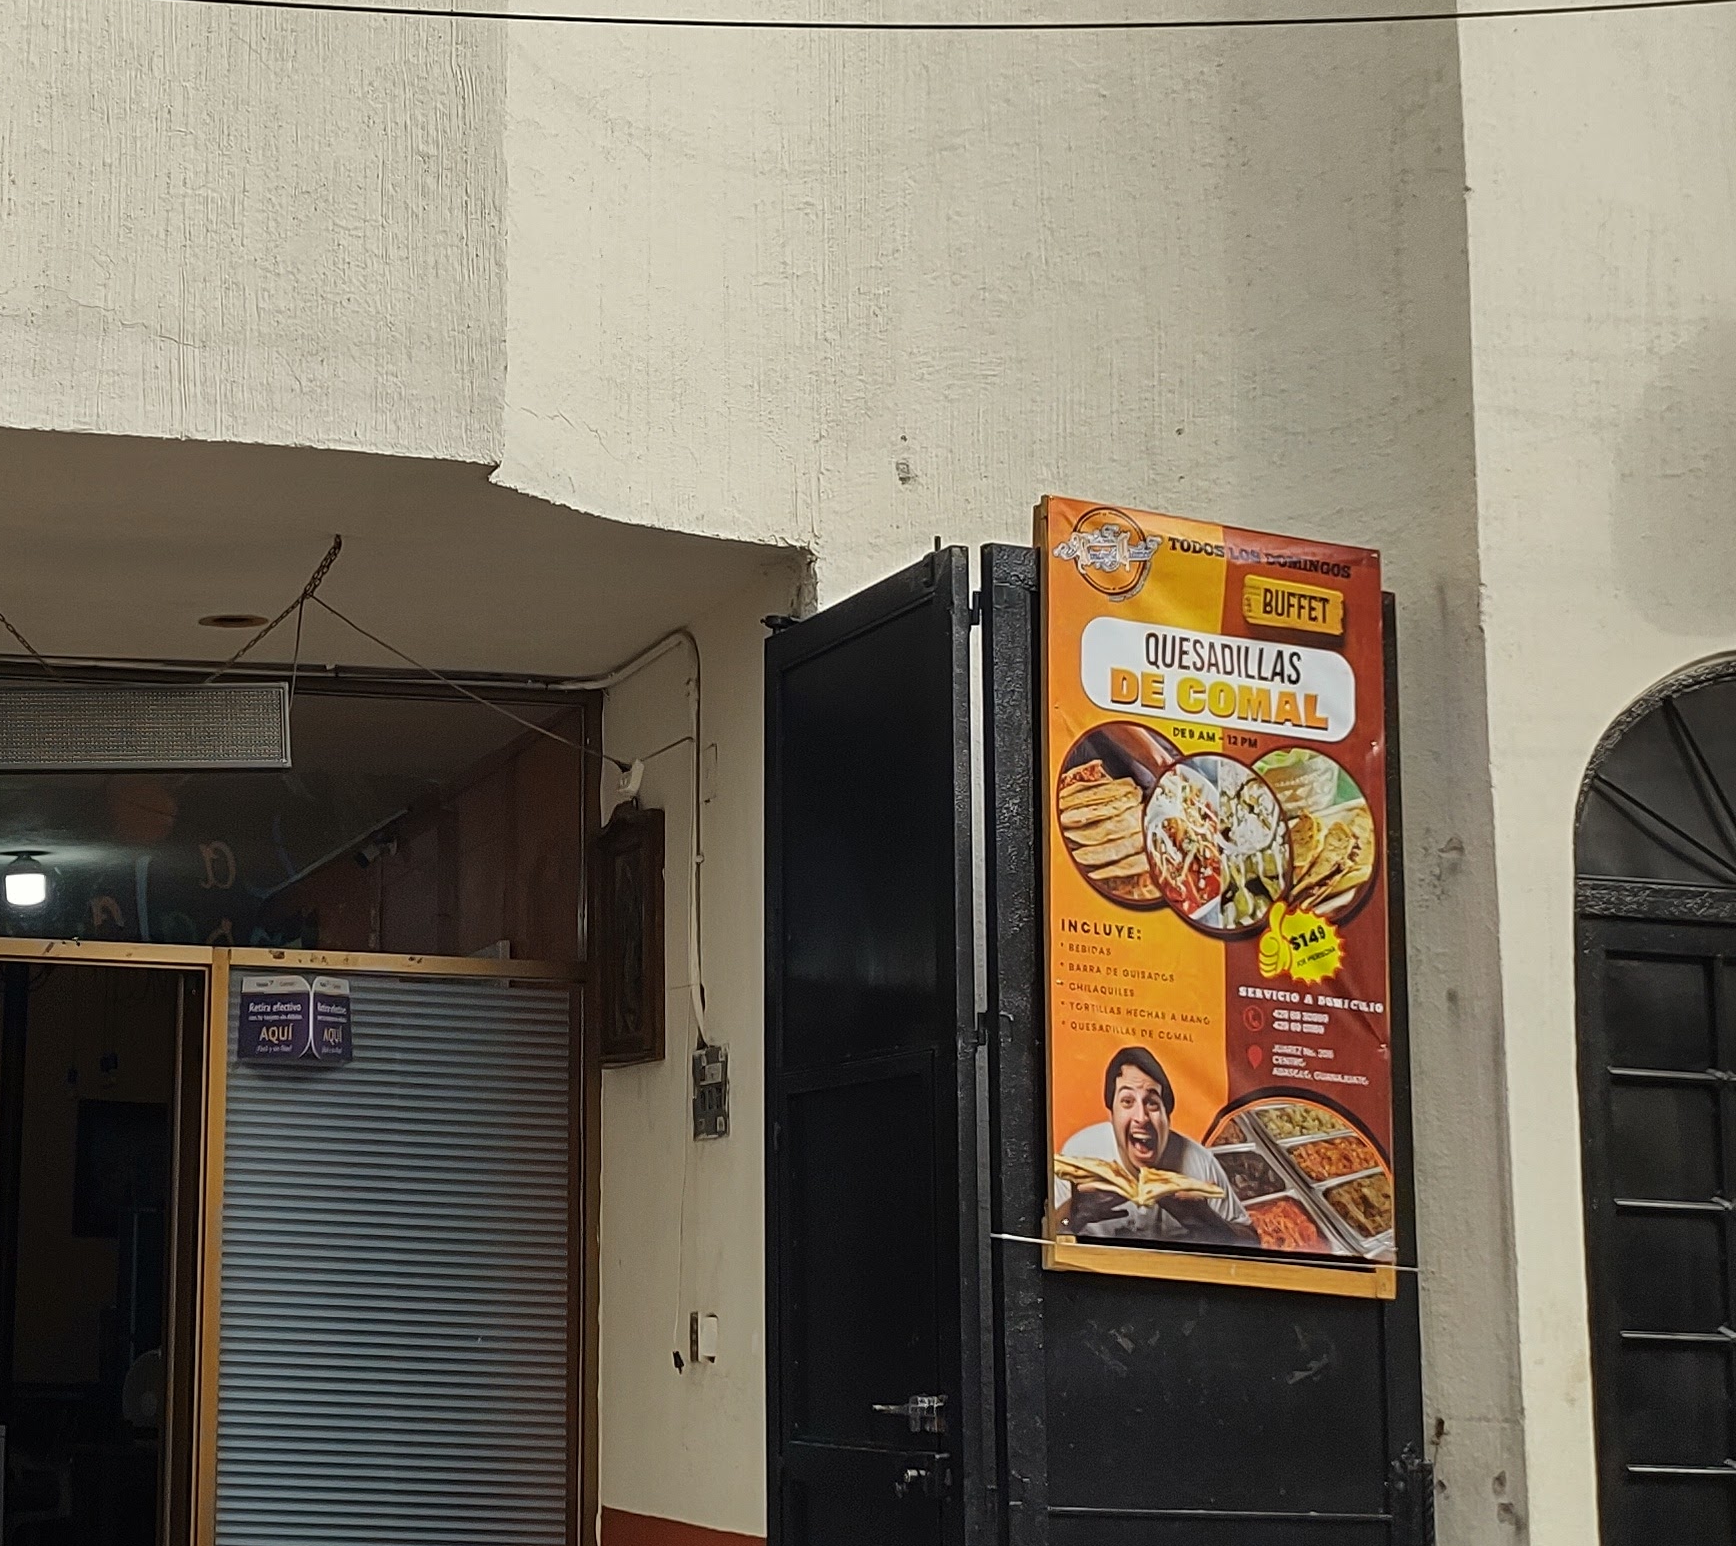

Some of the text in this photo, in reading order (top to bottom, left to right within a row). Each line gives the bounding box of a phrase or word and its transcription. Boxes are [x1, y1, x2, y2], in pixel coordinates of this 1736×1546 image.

[1168, 536, 1225, 558] TODOS
[1228, 546, 1262, 564] LOS
[1265, 553, 1351, 579] DOMINGOS
[1262, 588, 1330, 623] BUFFET
[1145, 632, 1302, 685] QUESADILLAS
[1110, 666, 1329, 731] DE COMAL
[1197, 730, 1216, 743] AM
[1227, 734, 1238, 746] 12
[1240, 736, 1258, 749] PM
[1061, 918, 1142, 940] INCLUYE:
[1290, 925, 1326, 951] $149
[1069, 943, 1112, 956] BEBIDAS
[1069, 962, 1175, 982] BARRA DE GUISADOS
[1069, 982, 1135, 997] CHILAQUILES
[1238, 986, 1300, 1003] SERVICIO
[1304, 994, 1314, 1005] A
[1070, 1001, 1211, 1025] TORTILLAS HECHAS A MANO
[260, 1023, 293, 1043] AQUÍ
[1070, 1021, 1194, 1043] QUESADILLAS DE COMAL
